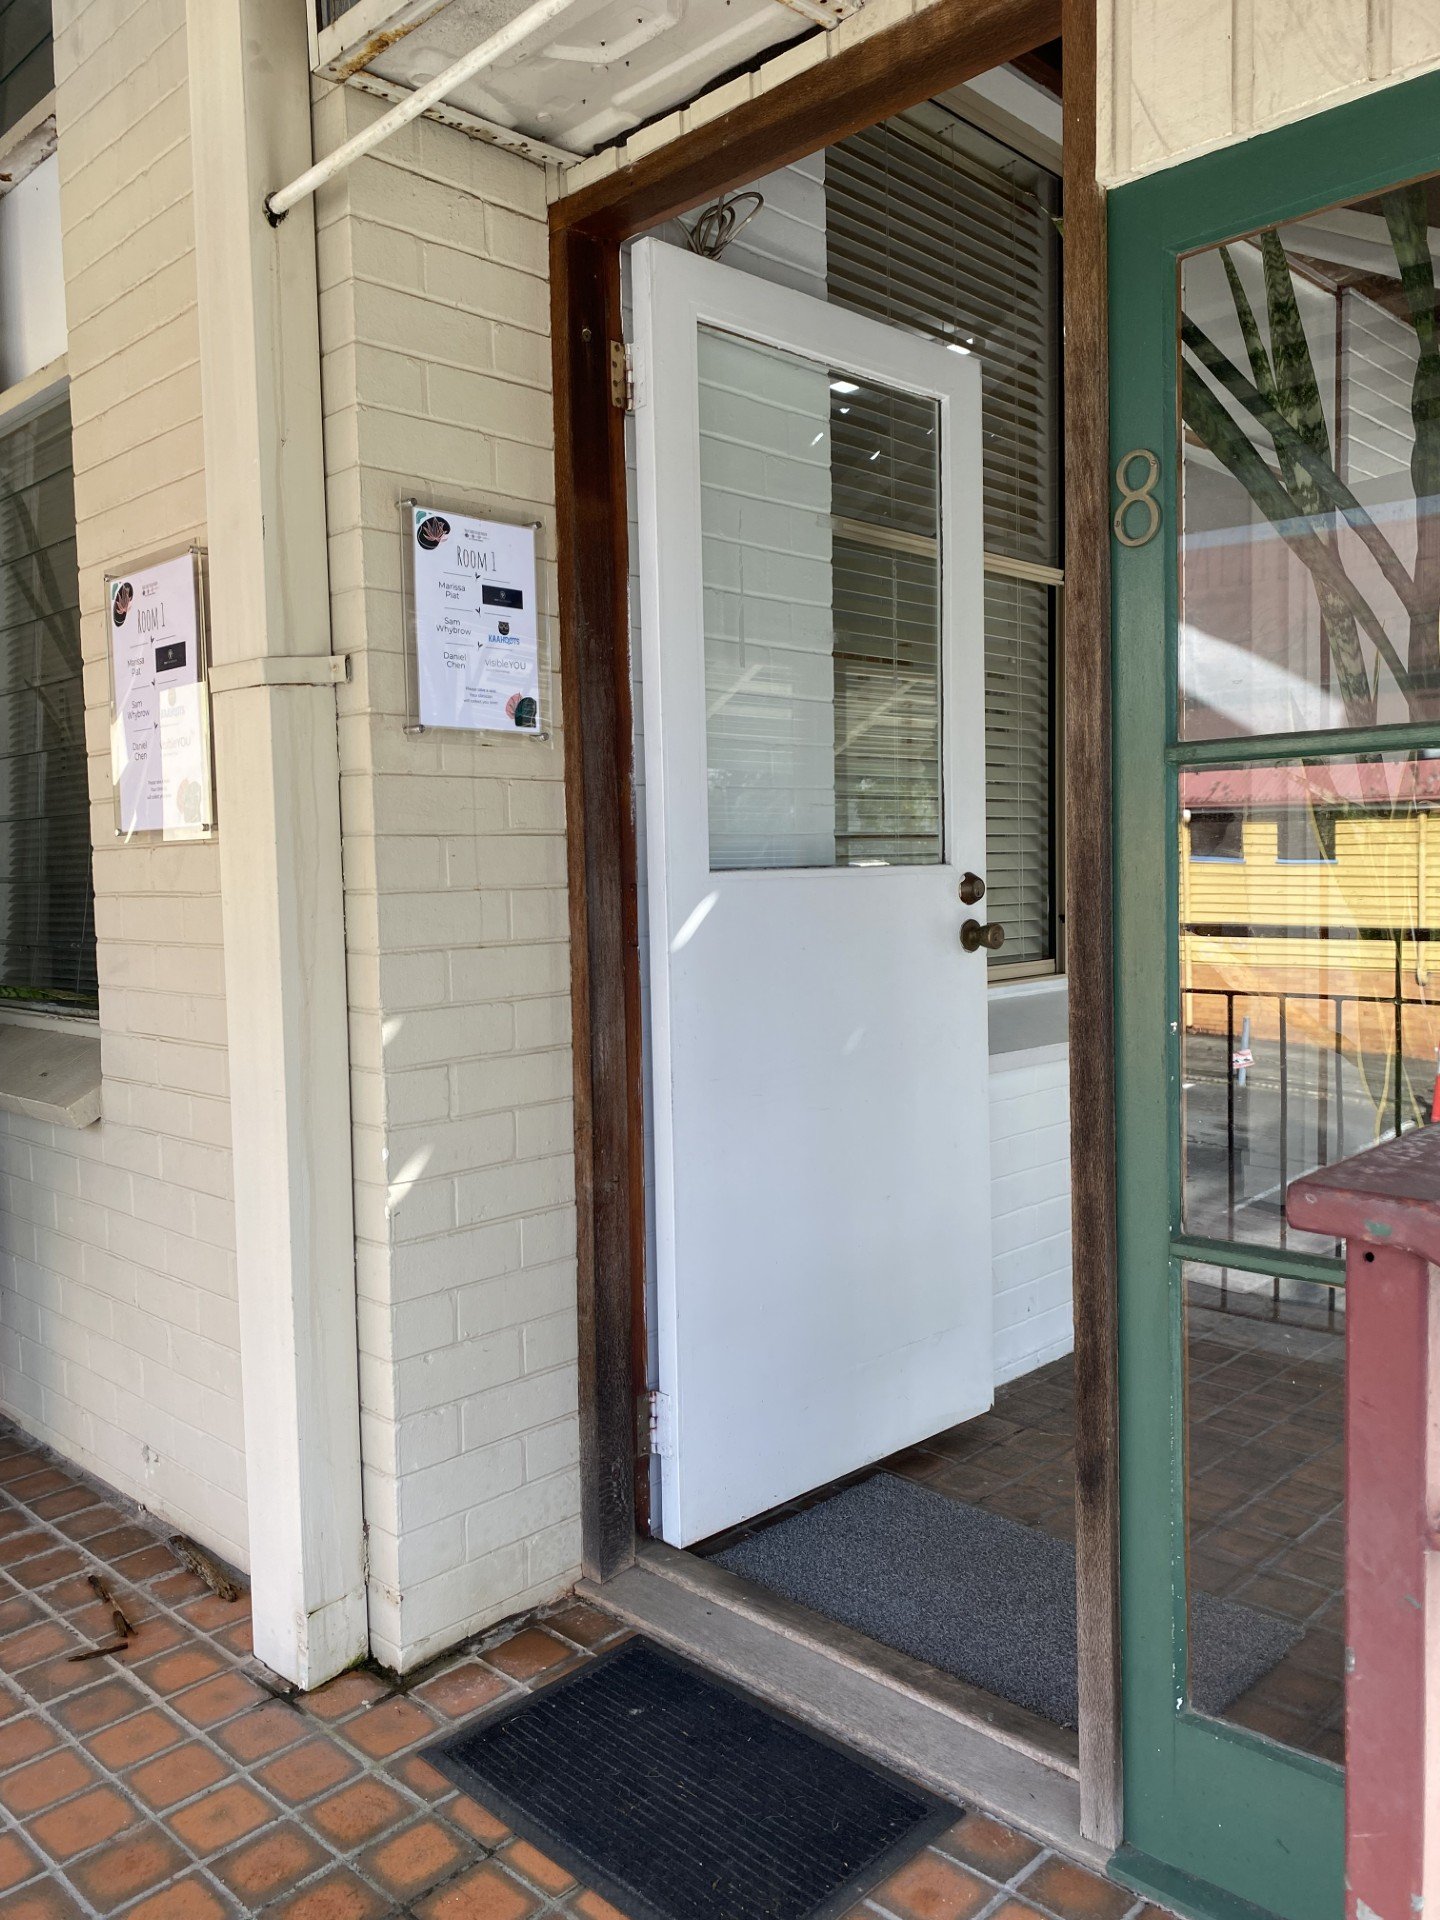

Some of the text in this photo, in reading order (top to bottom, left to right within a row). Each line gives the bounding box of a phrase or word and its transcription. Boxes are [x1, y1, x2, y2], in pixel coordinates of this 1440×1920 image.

[1113, 448, 1160, 547] 8
[457, 545, 496, 571] ROOM 1
[438, 581, 465, 591] Marissa
[445, 591, 460, 599] Piat
[137, 602, 165, 633] ROOM 1
[444, 617, 460, 625] Sam
[436, 624, 471, 635] Whybrow
[443, 651, 467, 661] Daniel
[446, 660, 465, 669] Chen
[131, 700, 143, 709] Sam
